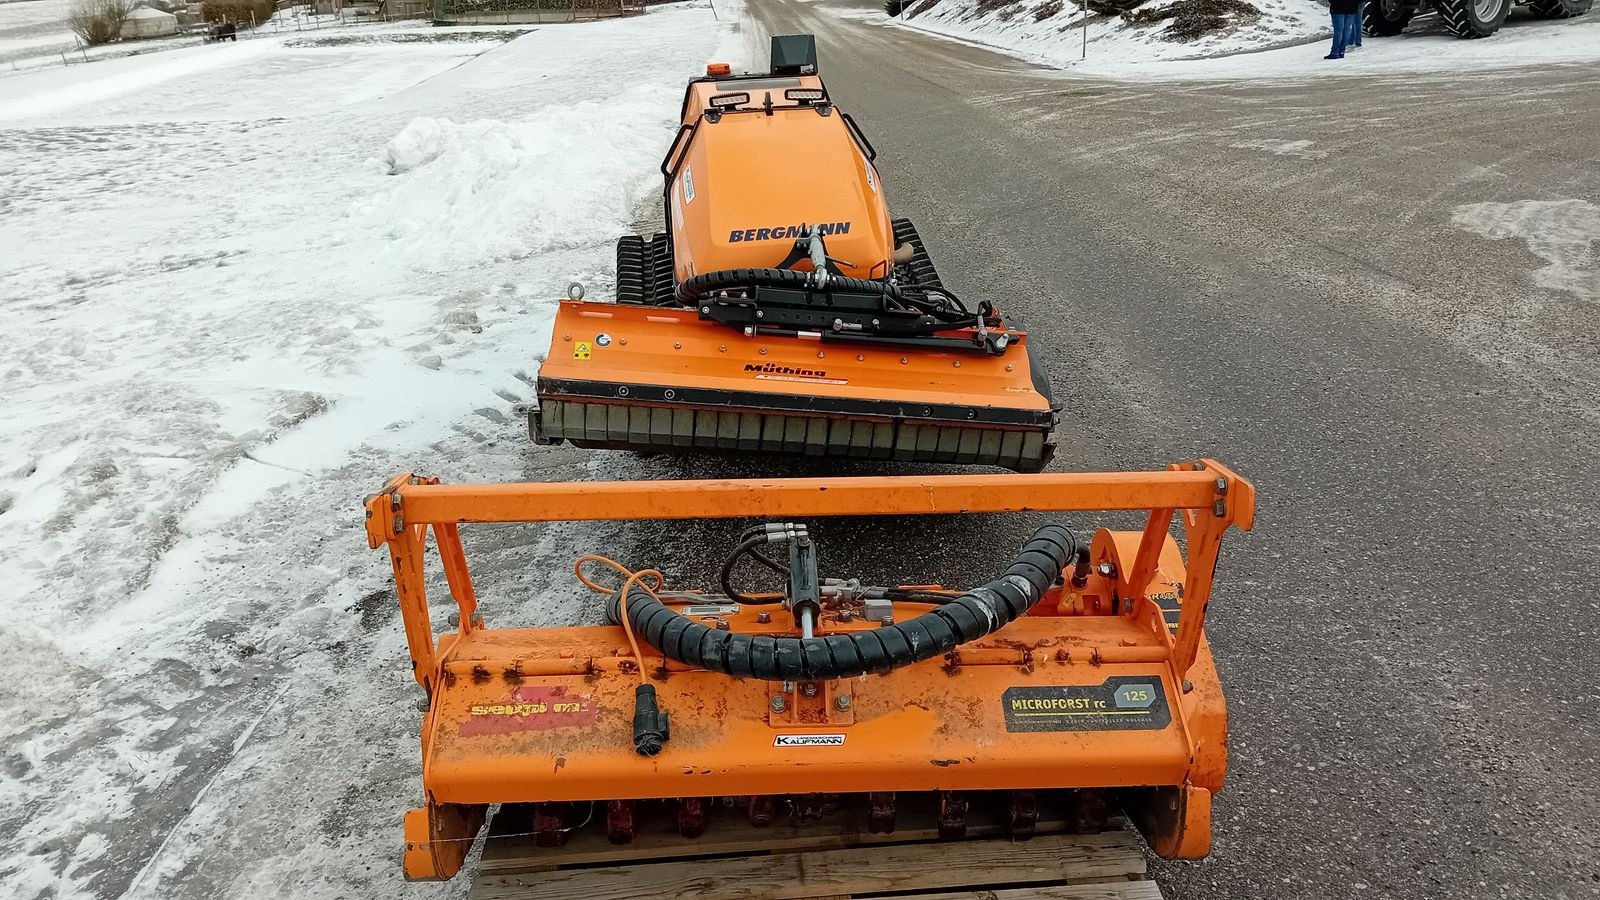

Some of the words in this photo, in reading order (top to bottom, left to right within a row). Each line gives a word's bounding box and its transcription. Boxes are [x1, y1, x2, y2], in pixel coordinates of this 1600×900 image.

[729, 222, 851, 243] BERGMNN
[1012, 699, 1090, 710] MICROFORST
[1094, 701, 1107, 709] rc
[1123, 690, 1148, 701] 125
[777, 737, 842, 745] KAUFMANN
